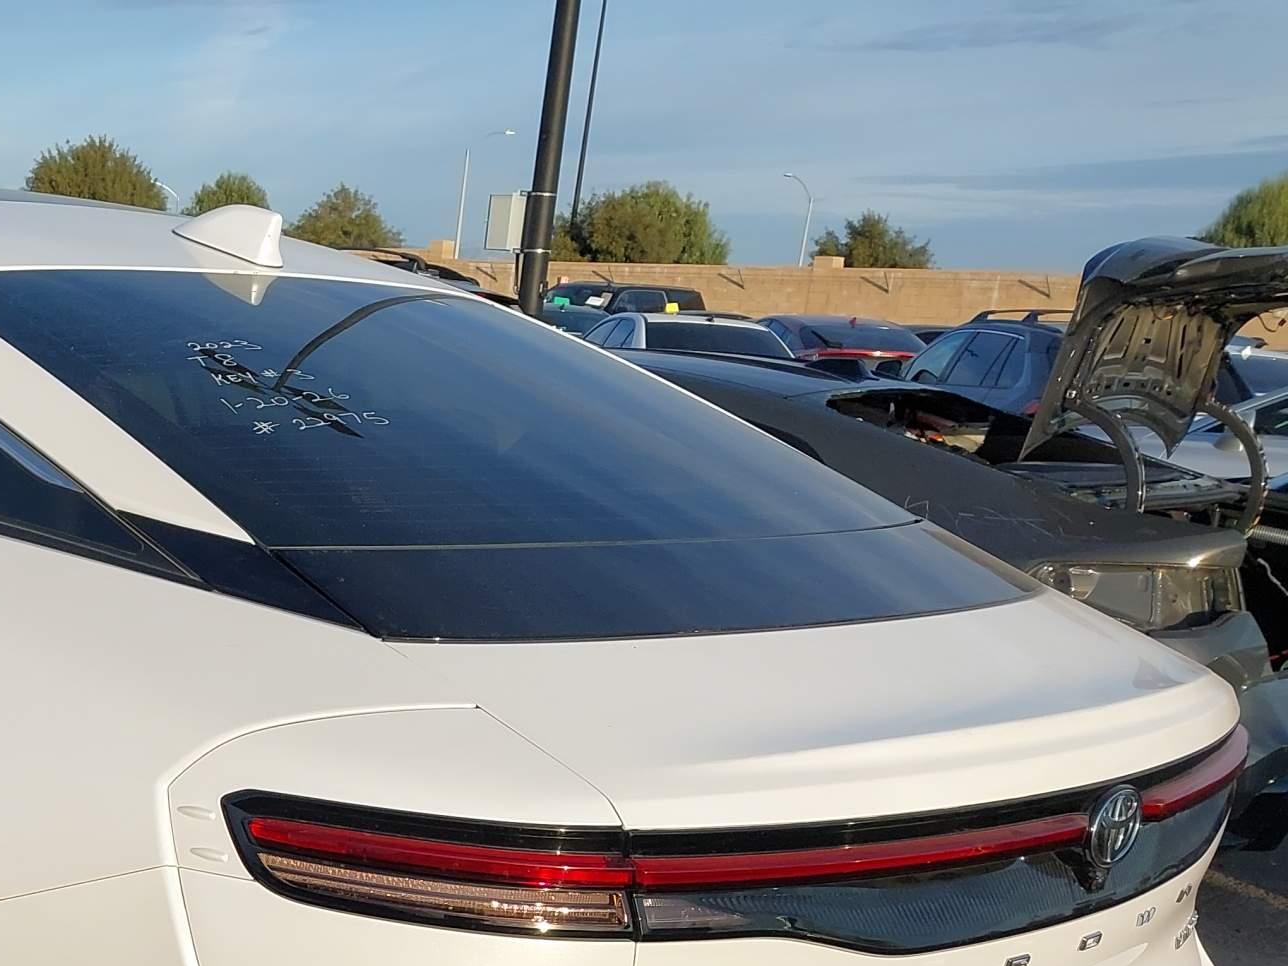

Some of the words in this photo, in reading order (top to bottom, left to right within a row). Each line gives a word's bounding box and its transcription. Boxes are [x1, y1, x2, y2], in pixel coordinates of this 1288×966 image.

[187, 339, 263, 351] 2023
[210, 371, 259, 386] KEY
[220, 387, 350, 415] 1-20-26
[292, 411, 390, 431] 22975
